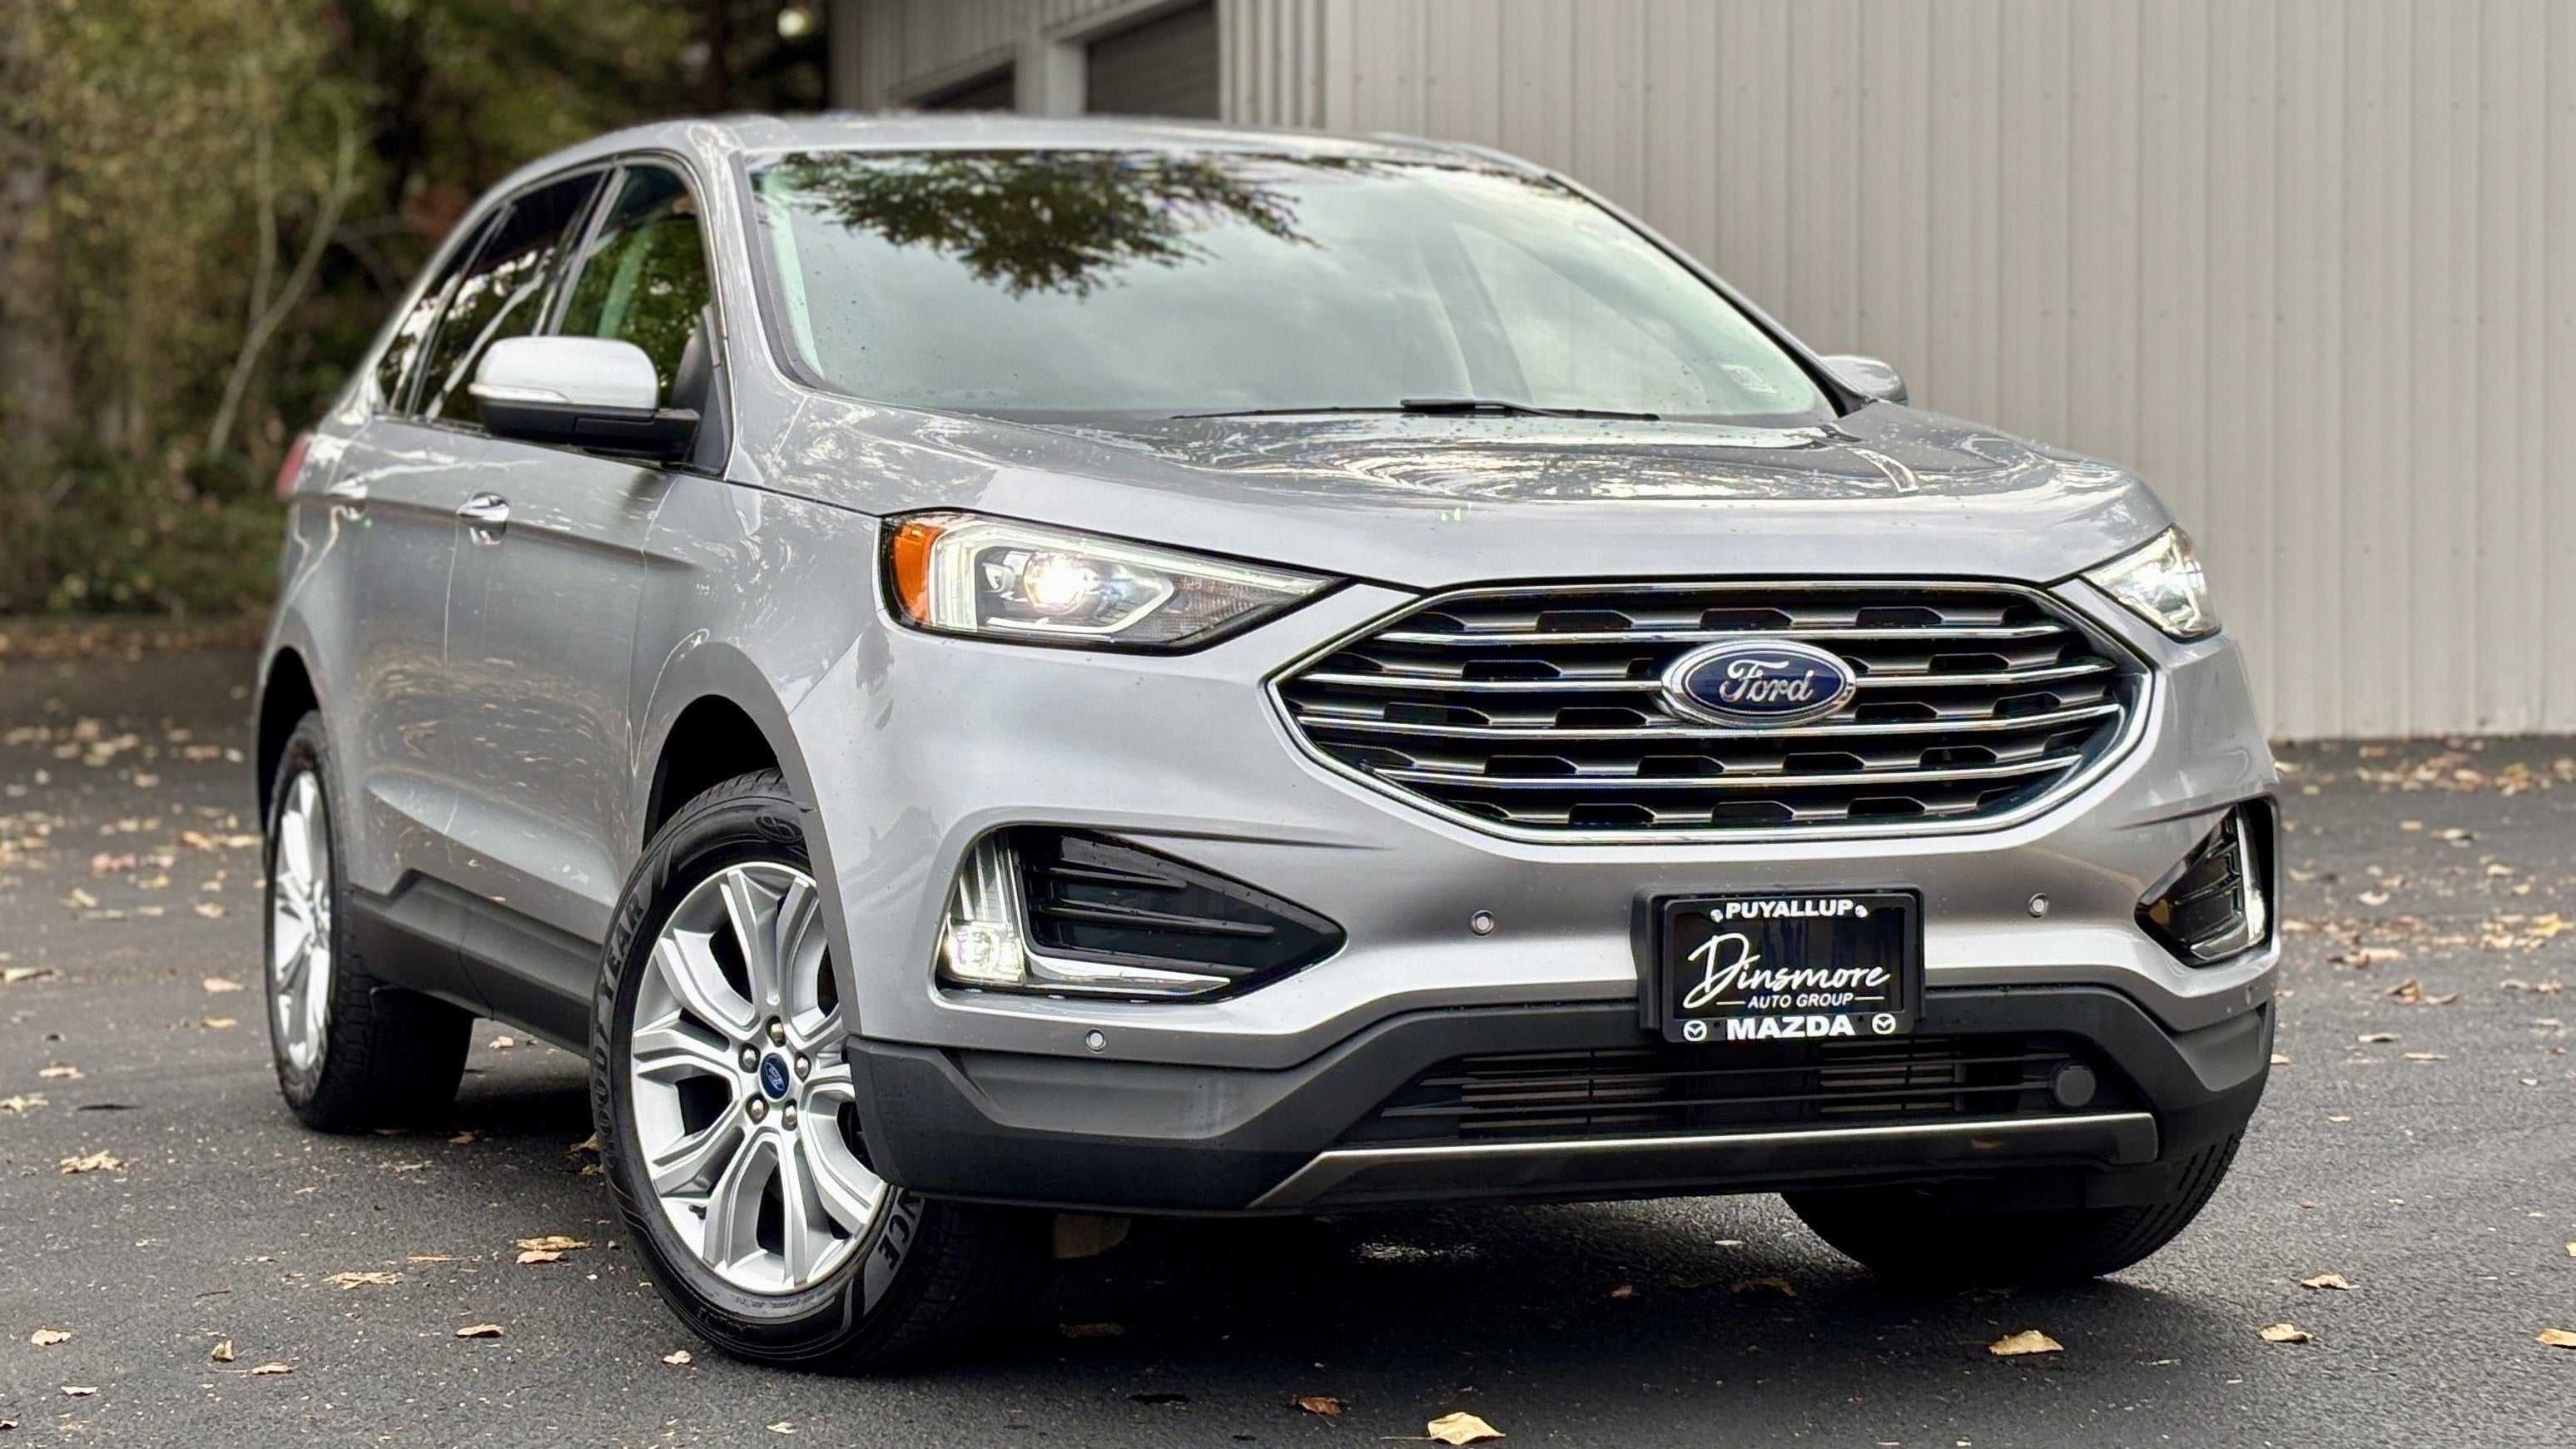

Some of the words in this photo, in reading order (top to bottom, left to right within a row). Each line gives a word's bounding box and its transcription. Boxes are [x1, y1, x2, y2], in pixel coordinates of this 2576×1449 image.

[1719, 659, 1814, 702] Ford
[1725, 900, 1854, 920] PUYALLUP
[1683, 933, 1890, 1009] Dinsmore
[1747, 995, 1790, 1009] AUTO
[1795, 994, 1854, 1008] GROUP
[1726, 1015, 1856, 1040] MAZDA
